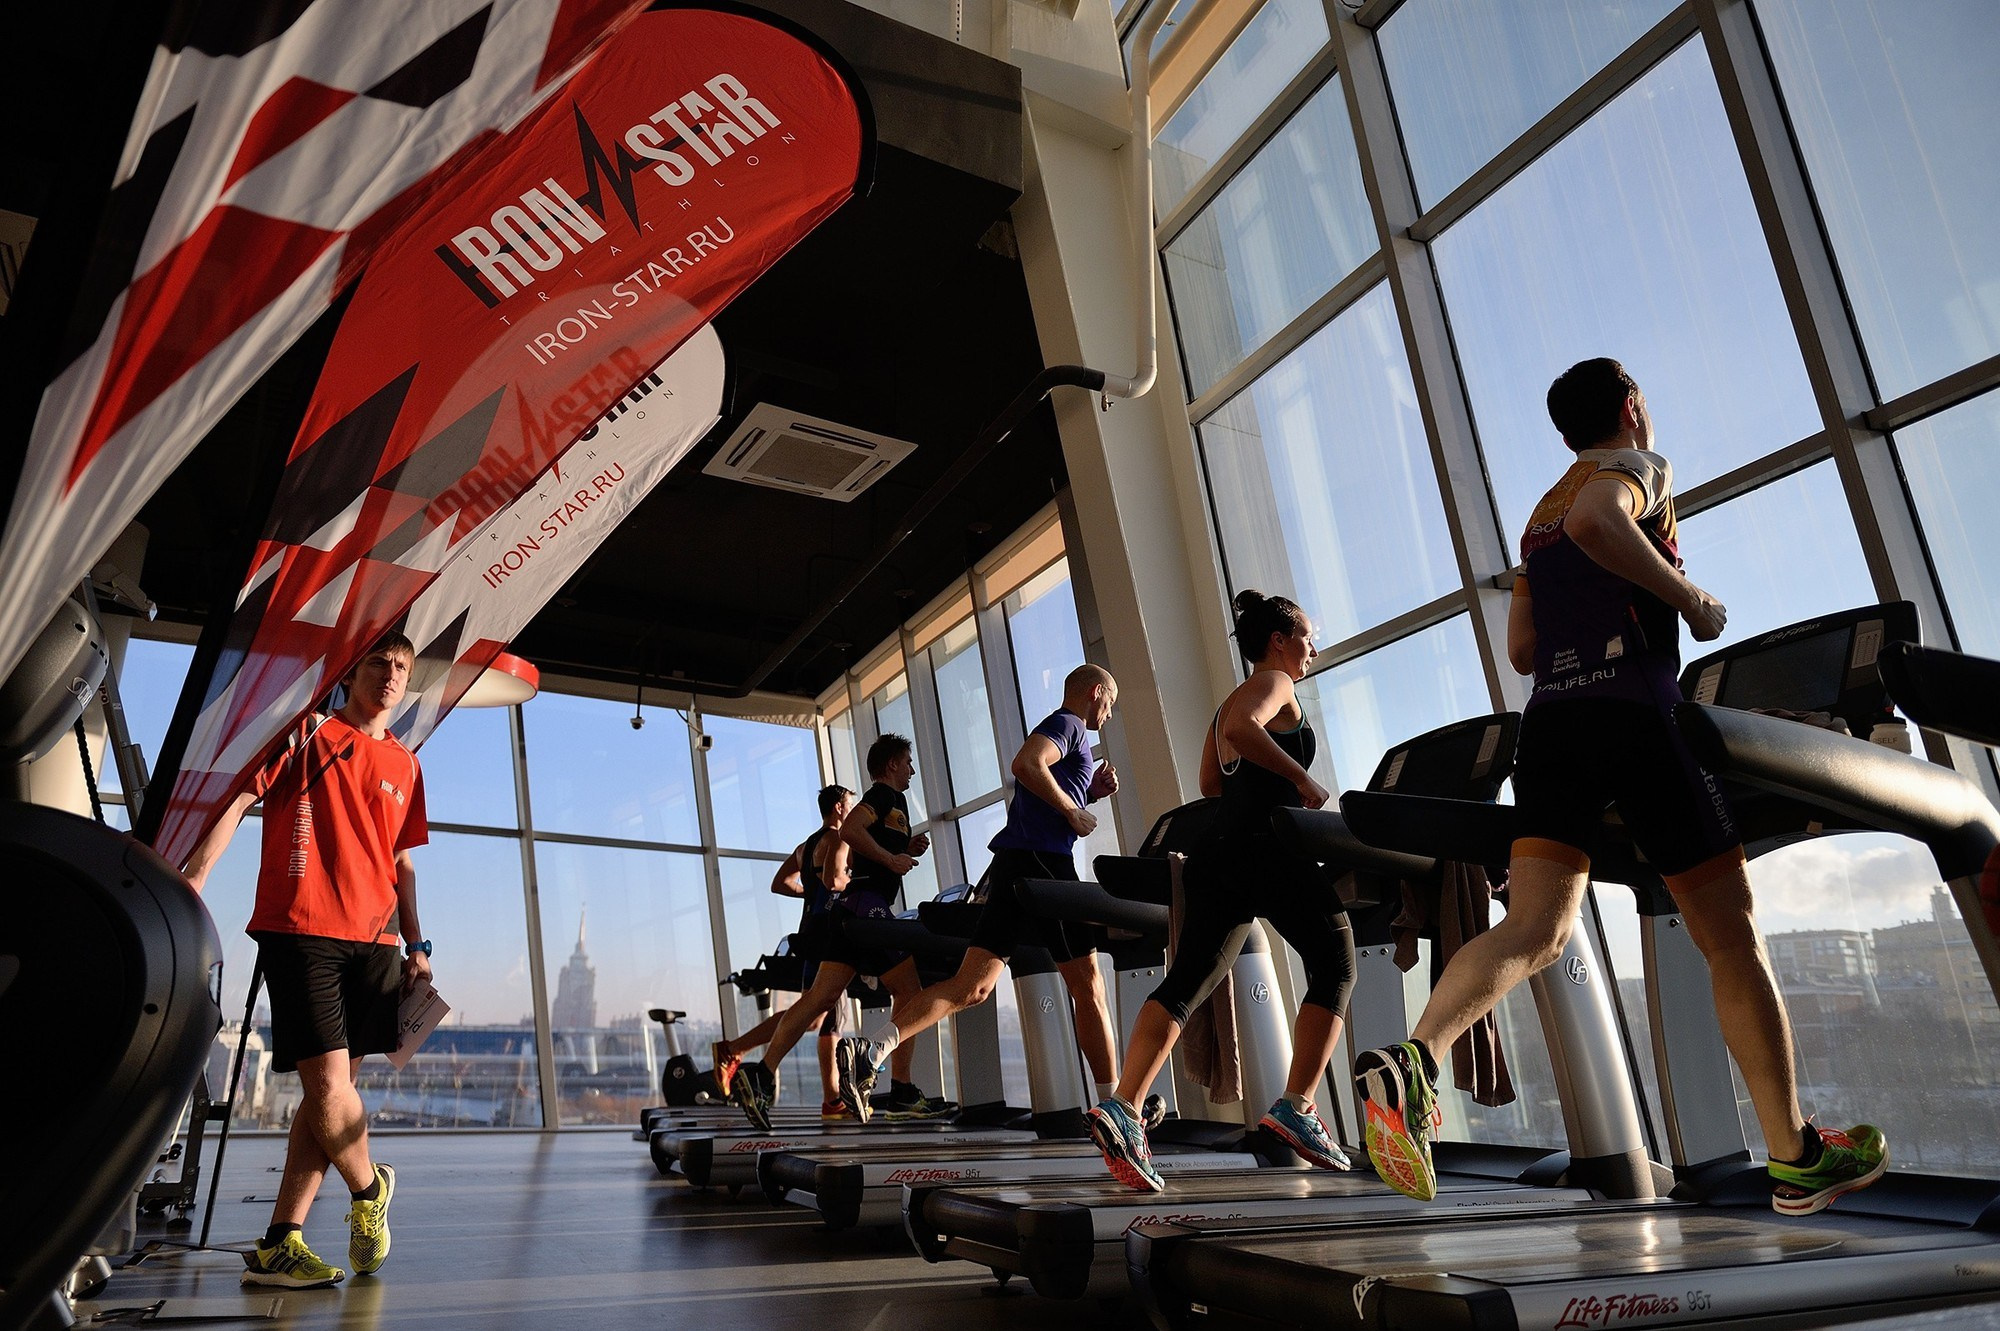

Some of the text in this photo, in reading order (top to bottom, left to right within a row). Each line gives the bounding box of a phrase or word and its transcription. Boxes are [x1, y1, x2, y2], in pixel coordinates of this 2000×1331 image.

[434, 72, 782, 310] IRON STAR
[499, 132, 797, 328] TRIATHLON
[524, 215, 736, 366] IRON-STAR.RU
[481, 462, 626, 589] IRON-STAR.RU
[288, 799, 315, 878] IRON-STAR.RU
[1686, 1290, 1712, 1312] 95T
